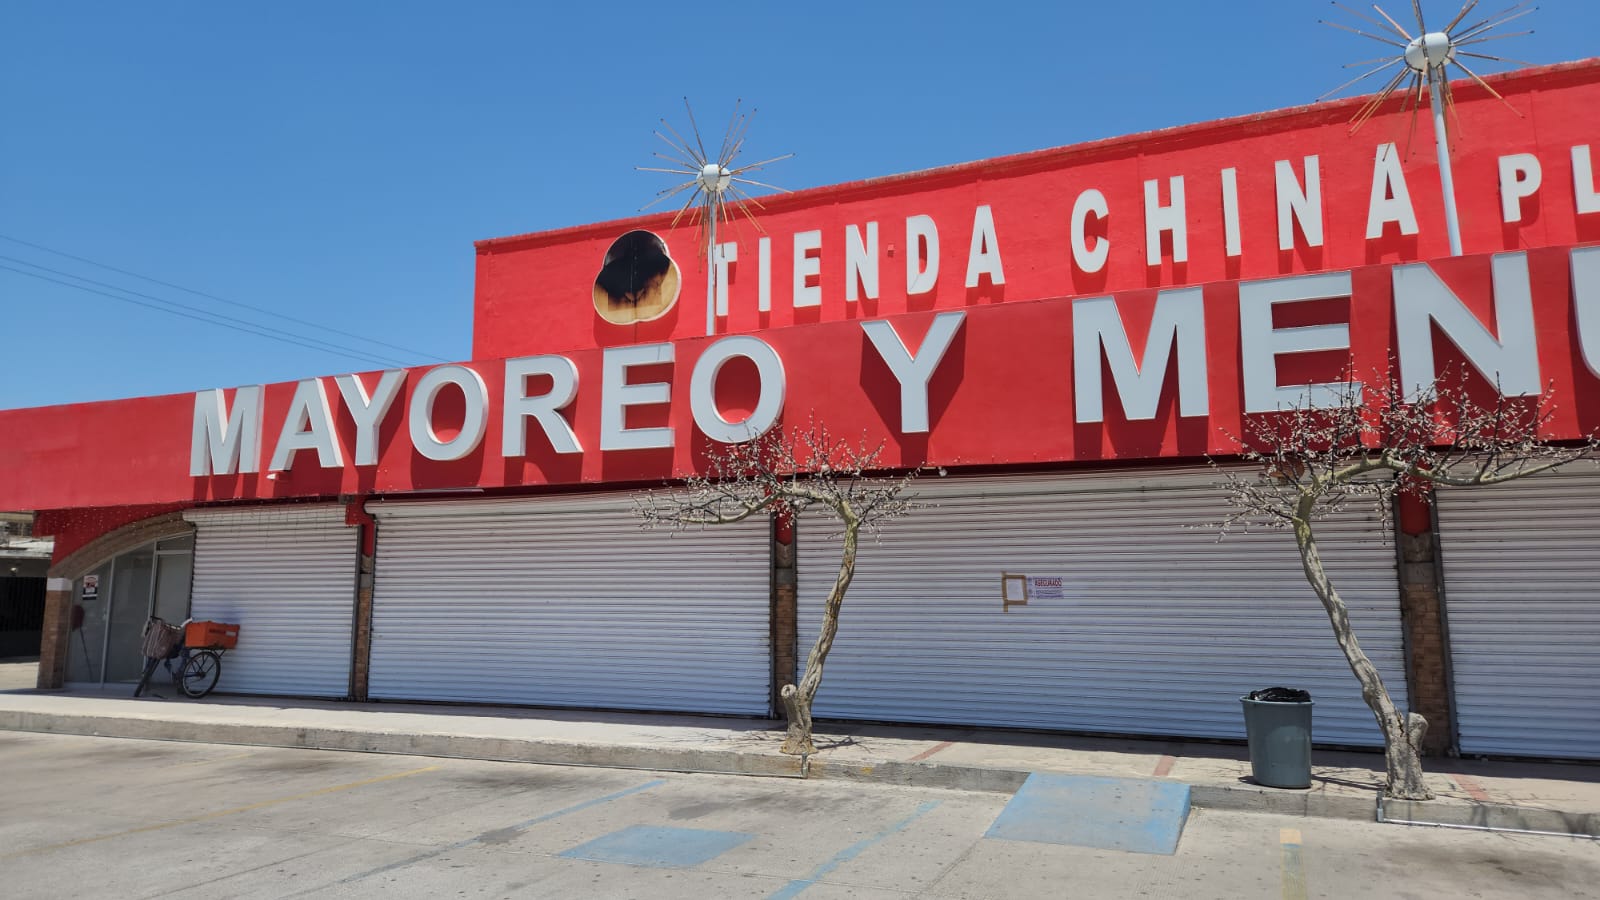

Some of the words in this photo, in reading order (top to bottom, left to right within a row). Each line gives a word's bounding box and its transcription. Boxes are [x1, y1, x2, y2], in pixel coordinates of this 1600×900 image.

[713, 204, 1006, 317] TIENDA
[1070, 142, 1420, 274] CHINA
[189, 335, 787, 478] MAYOREO
[861, 311, 967, 434] Y
[1072, 246, 1600, 423] MEN
